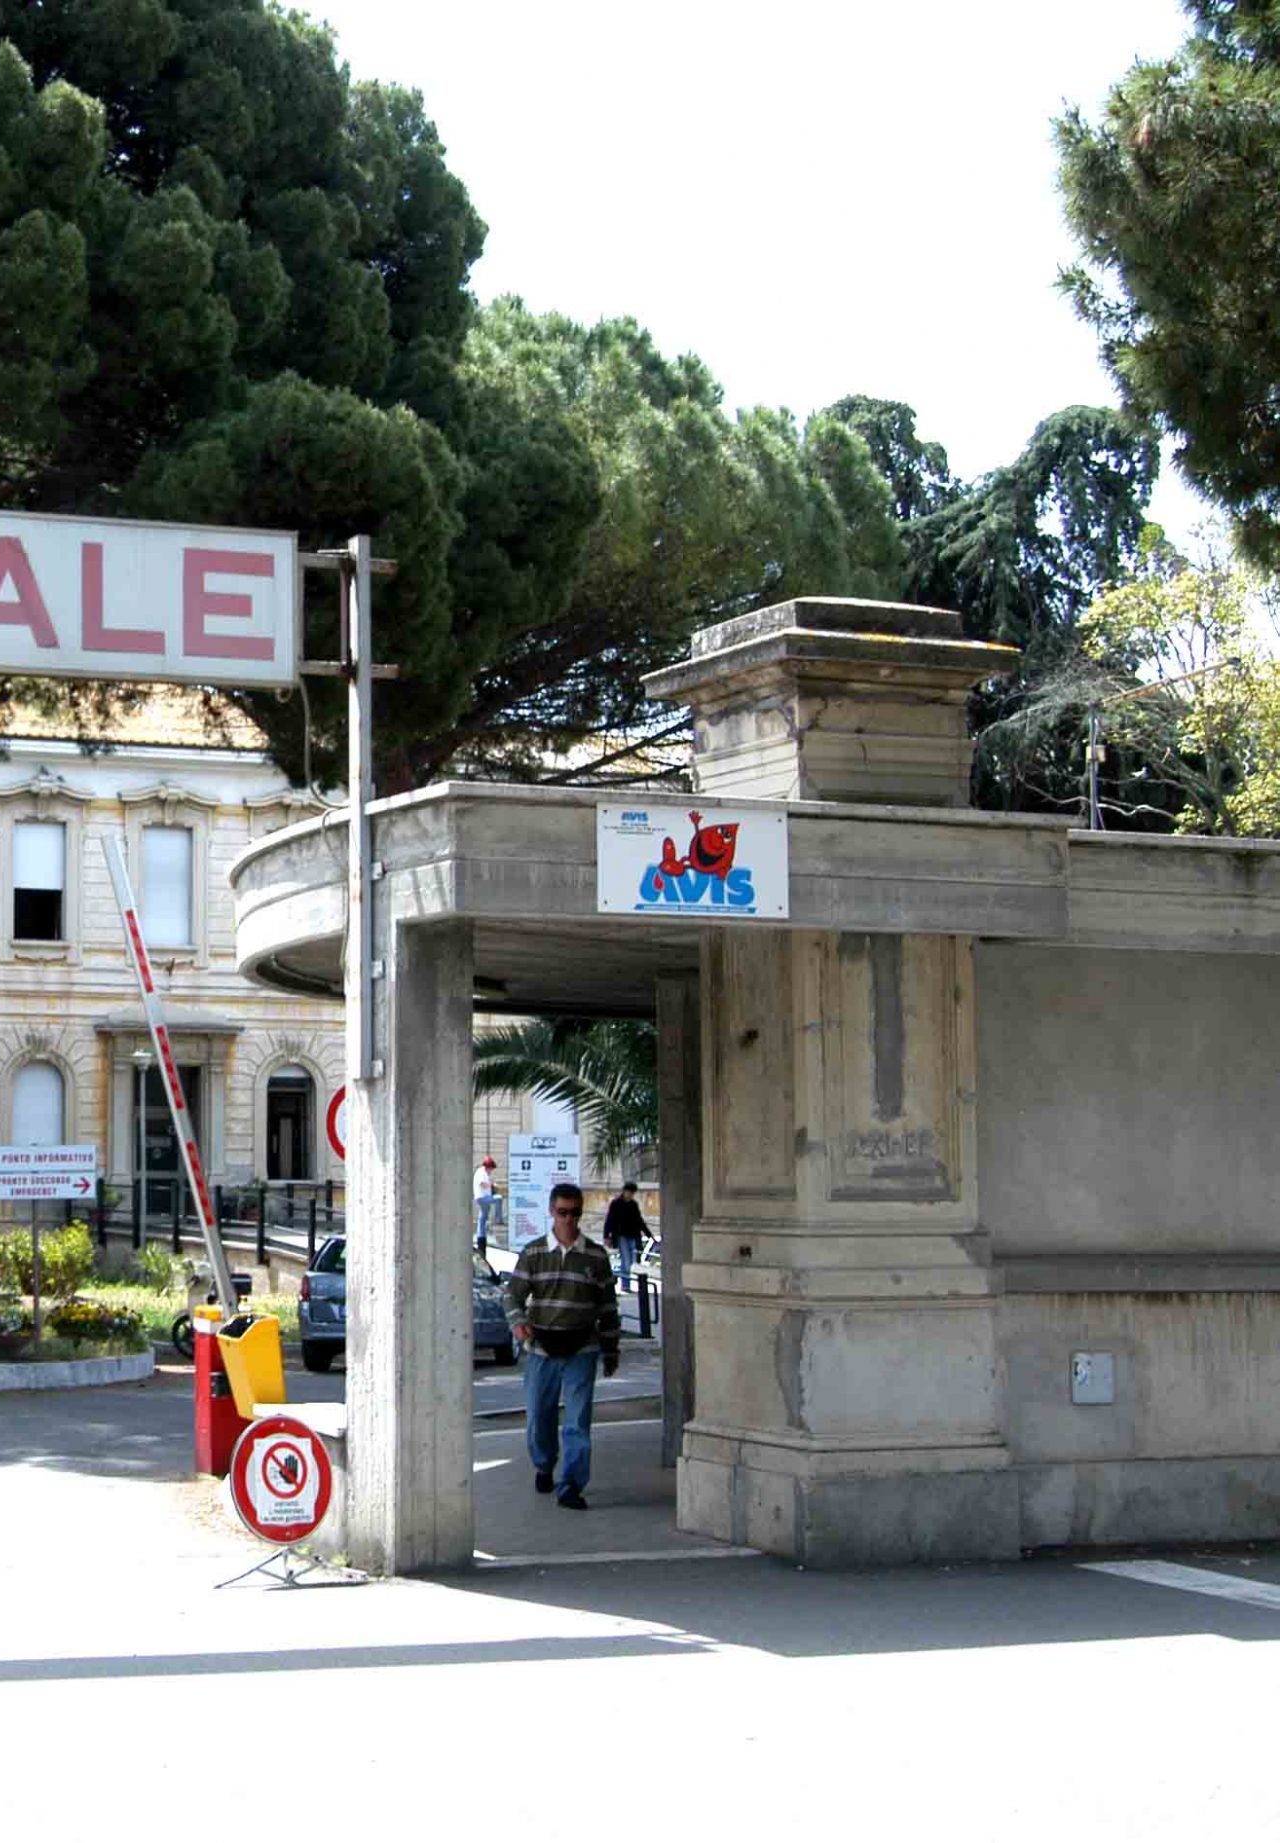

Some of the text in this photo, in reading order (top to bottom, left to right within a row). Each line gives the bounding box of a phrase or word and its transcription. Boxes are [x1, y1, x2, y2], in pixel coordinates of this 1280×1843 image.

[622, 812, 648, 822] AVIS
[639, 864, 755, 906] AVIS
[34, 1153, 93, 1163] INFORMATIVO
[31, 1176, 71, 1185] SOCCORSO
[11, 1187, 57, 1197] EMERGENCY
